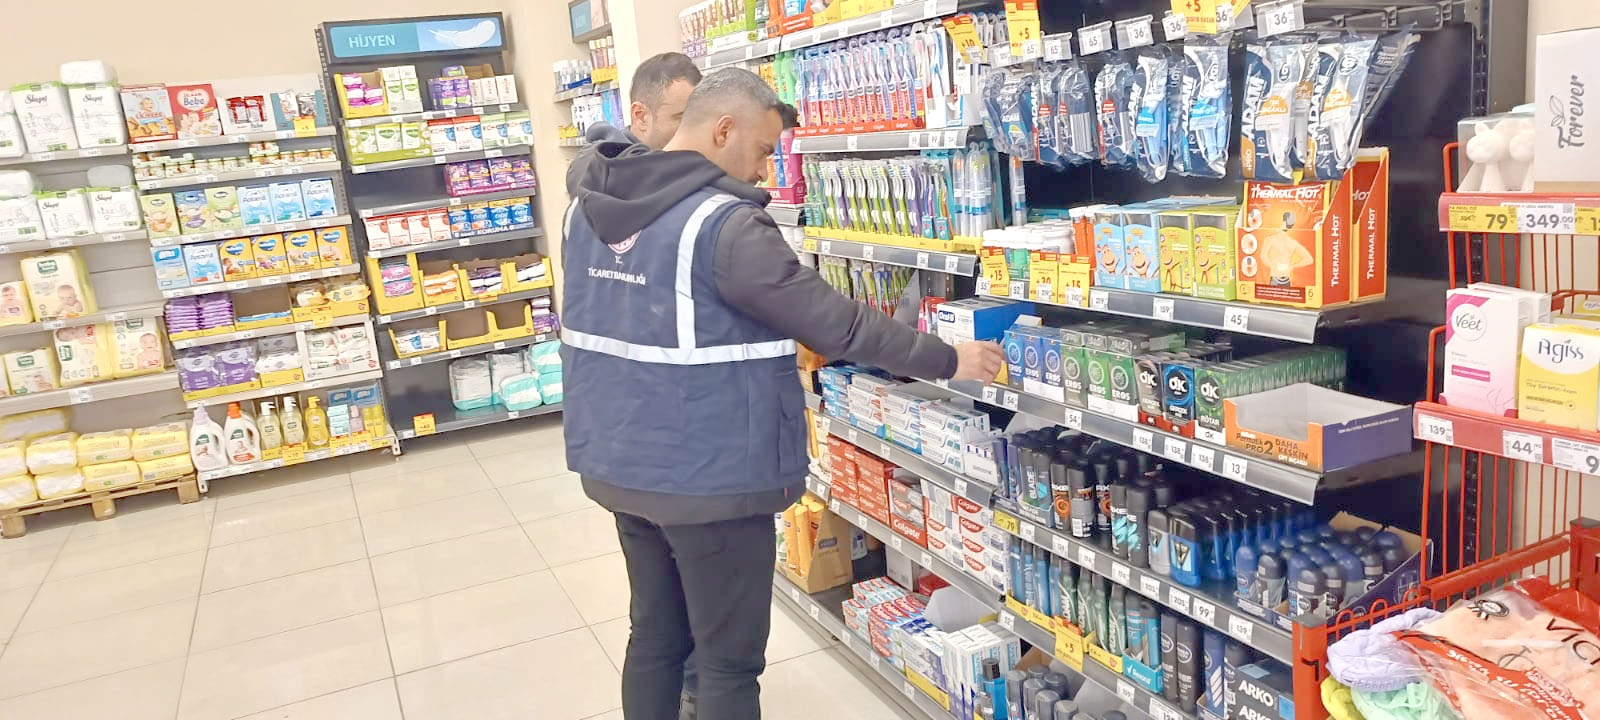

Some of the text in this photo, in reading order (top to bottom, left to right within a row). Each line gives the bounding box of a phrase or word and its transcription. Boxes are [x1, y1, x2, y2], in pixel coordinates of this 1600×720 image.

[1216, 10, 1228, 23] 36
[1274, 13, 1288, 25] 36
[1169, 21, 1181, 33] 36
[1134, 28, 1145, 39] 36
[1088, 37, 1098, 47] 65
[1026, 46, 1035, 54] 65
[1050, 46, 1059, 54] 65
[183, 97, 205, 106] Bebe
[1242, 76, 1265, 141] ADAM
[1557, 74, 1585, 149] Forever
[1251, 184, 1320, 200] THERMAL HOT
[1485, 214, 1508, 229] 79
[477, 225, 509, 235] KORUMA
[1367, 208, 1376, 280] THERMAL HOT
[1330, 214, 1340, 288] THERMAL HOT
[1230, 314, 1242, 325] 45
[1455, 313, 1482, 331] Veet
[1538, 338, 1584, 364] Agiss
[1008, 363, 1022, 373] EROS
[1025, 367, 1040, 377] EROS
[1045, 372, 1061, 382] EROS
[1064, 379, 1082, 389] EROS
[1089, 383, 1106, 394] EROS
[1112, 389, 1131, 400] EROS
[1069, 414, 1077, 423] 54
[1429, 425, 1445, 435] 139
[1246, 443, 1264, 453] PRO
[1275, 438, 1299, 450] DAHA
[1512, 440, 1533, 455] 44
[1278, 446, 1309, 460] KESKİN
[1231, 463, 1241, 474] 13
[1586, 455, 1599, 474] 9
[1028, 470, 1037, 498] BLADE
[959, 498, 981, 511] Colgate
[893, 519, 921, 539] Colgate
[961, 518, 983, 531] Colgate
[1199, 606, 1210, 618] 99
[1546, 618, 1600, 666] VIC
[1238, 679, 1274, 707] ARKO
